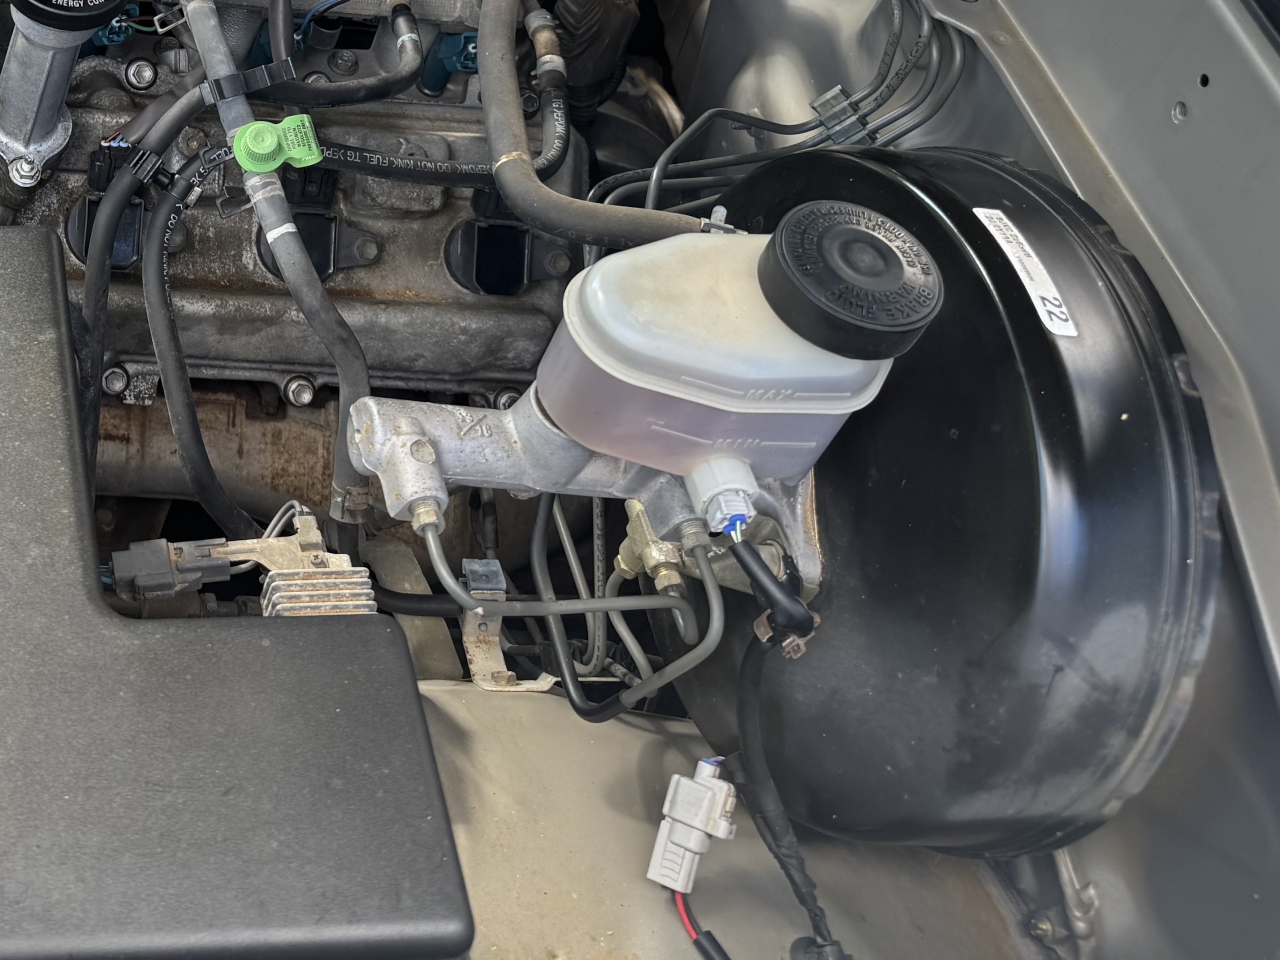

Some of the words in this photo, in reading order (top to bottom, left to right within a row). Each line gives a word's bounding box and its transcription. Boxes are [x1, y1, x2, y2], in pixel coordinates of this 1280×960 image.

[347, 150, 360, 162] TG
[363, 152, 388, 166] FUEL
[416, 160, 435, 172] NOT
[438, 162, 450, 173] DO
[884, 286, 933, 321] BRAKE
[1038, 296, 1069, 323] 22
[745, 389, 794, 401] MAX
[714, 438, 760, 448] MIN
